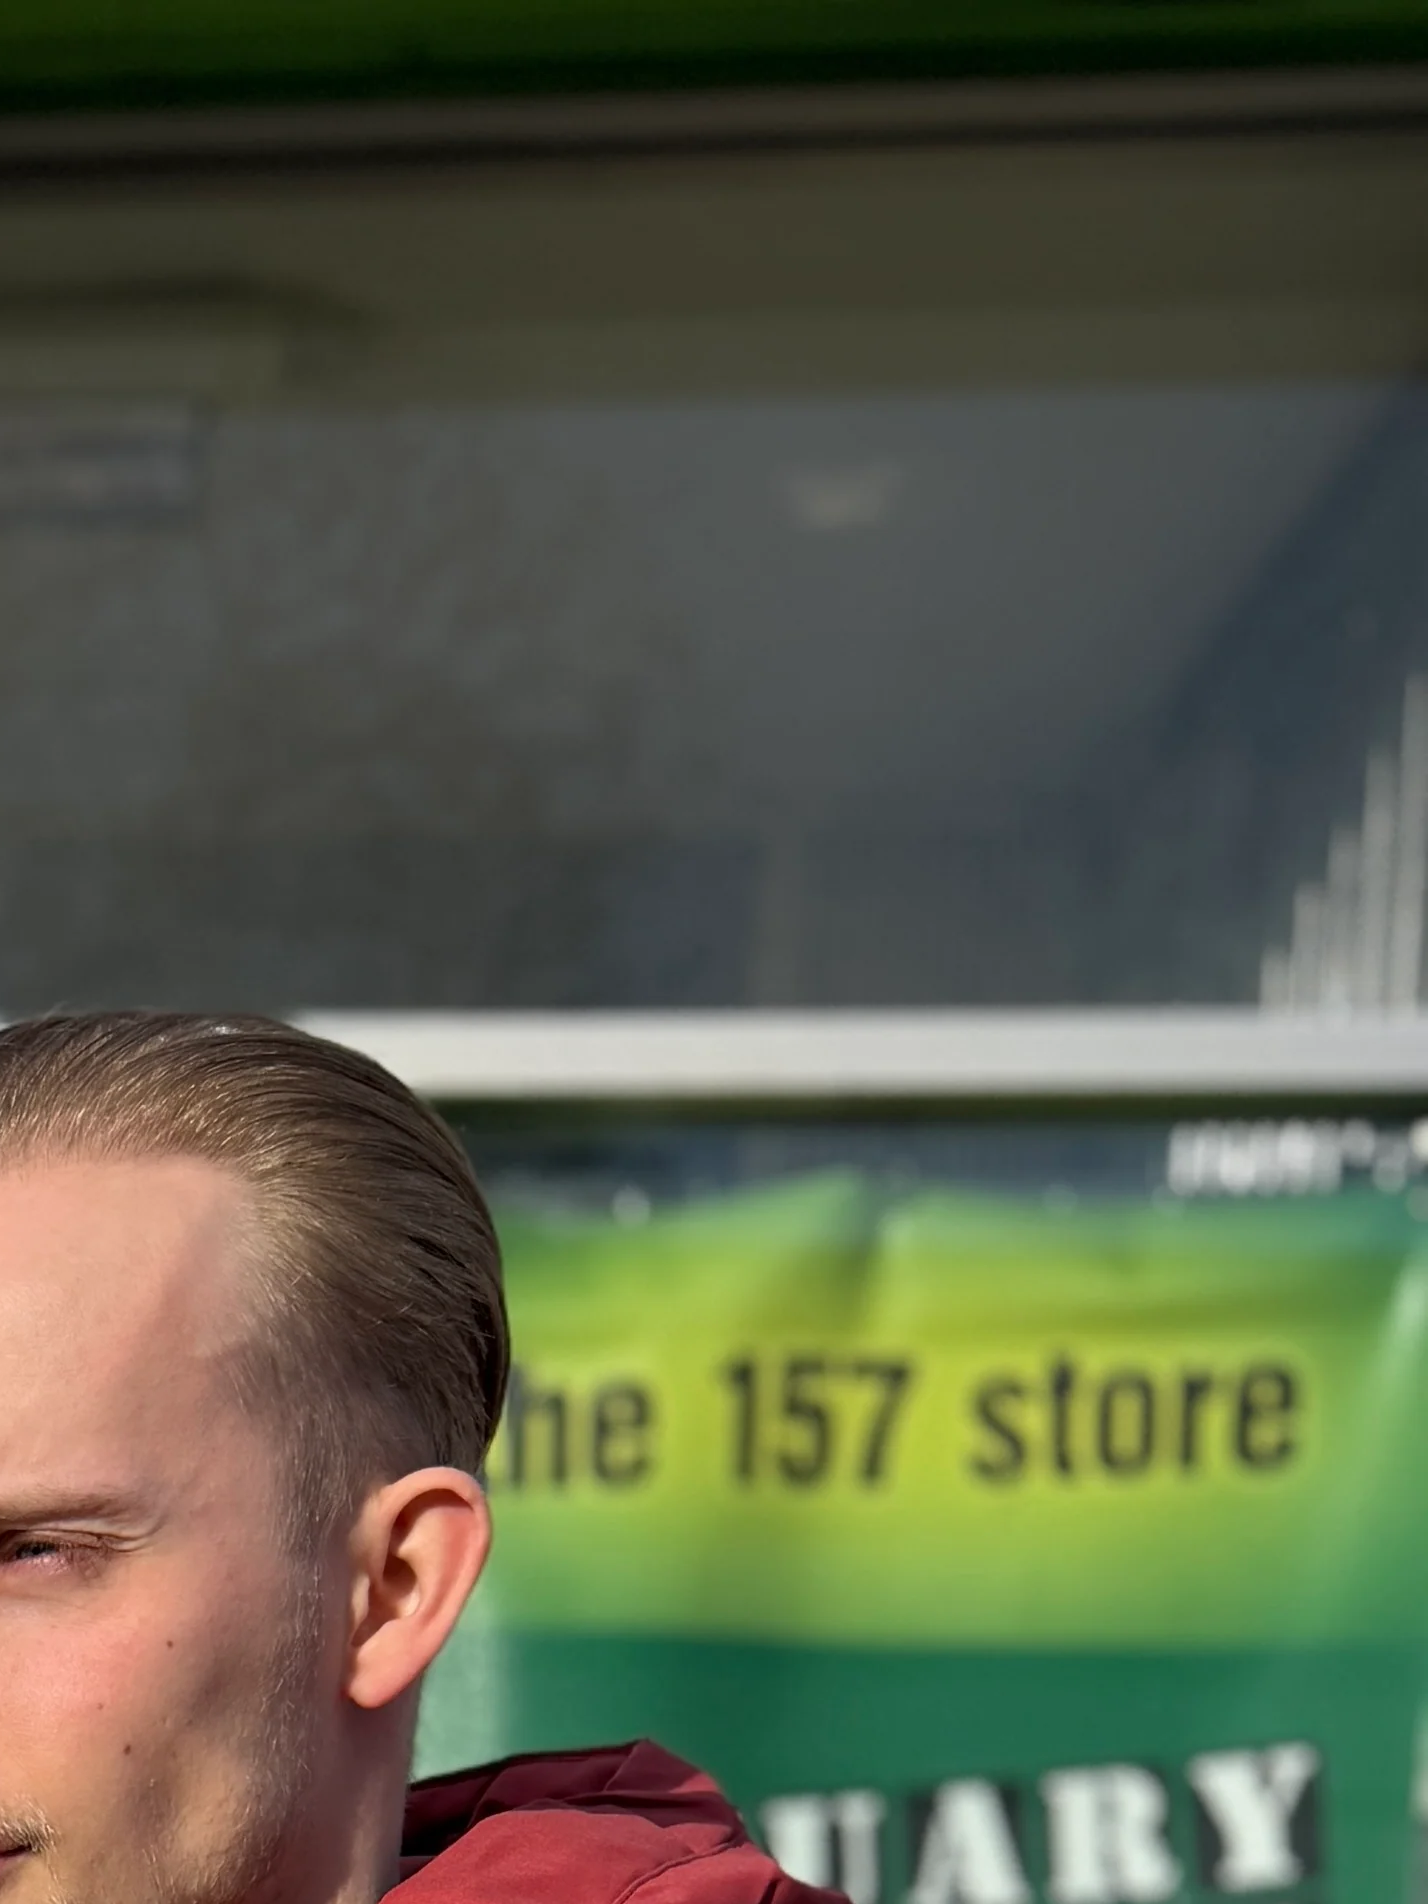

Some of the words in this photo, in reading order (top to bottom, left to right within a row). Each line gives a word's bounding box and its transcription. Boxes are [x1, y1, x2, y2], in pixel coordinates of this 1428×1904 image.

[484, 1352, 658, 1492] he
[720, 1348, 918, 1490] 157
[967, 1350, 1299, 1488] store
